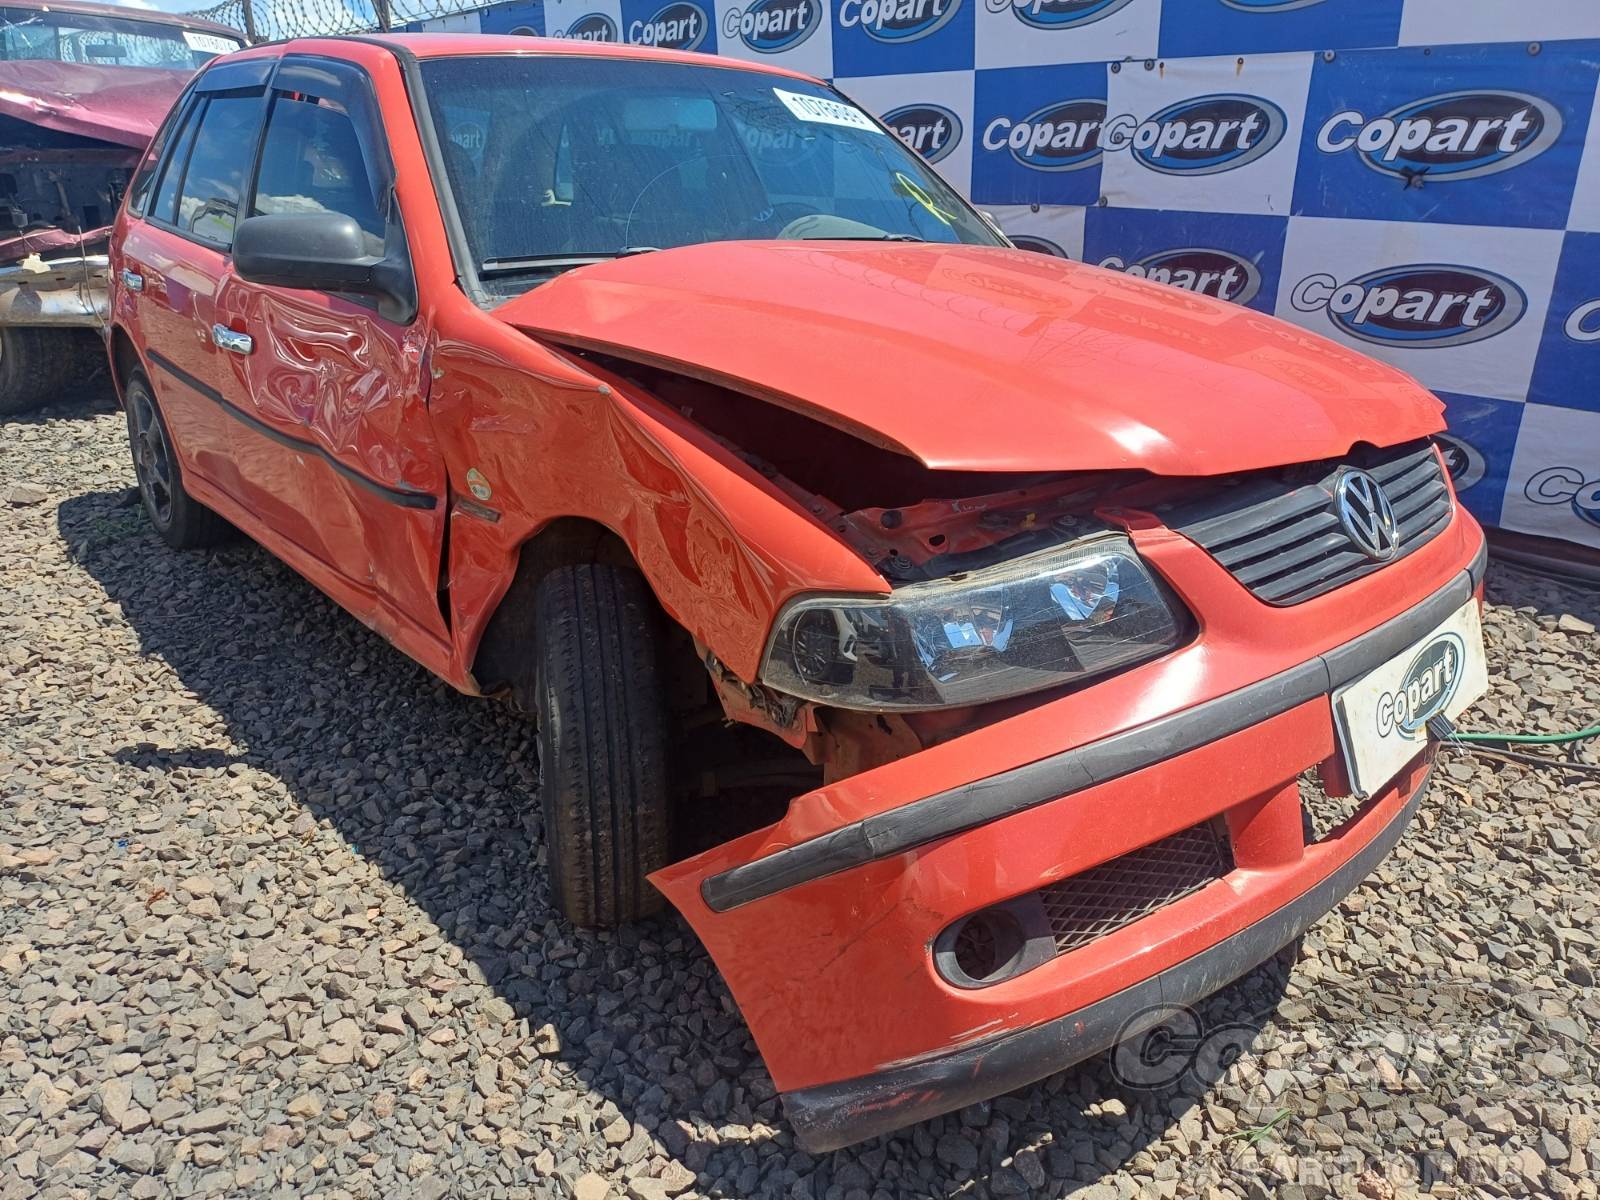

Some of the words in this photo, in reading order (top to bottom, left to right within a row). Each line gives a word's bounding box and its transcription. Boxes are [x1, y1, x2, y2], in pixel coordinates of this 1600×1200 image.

[553, 23, 608, 43] art
[628, 13, 698, 48] Copart
[722, 2, 808, 40] Copart
[887, 119, 946, 150] art
[1102, 111, 1262, 158] Copart
[1315, 108, 1530, 162] Copart
[1290, 272, 1493, 327] Copart
[1376, 648, 1455, 738] Copart
